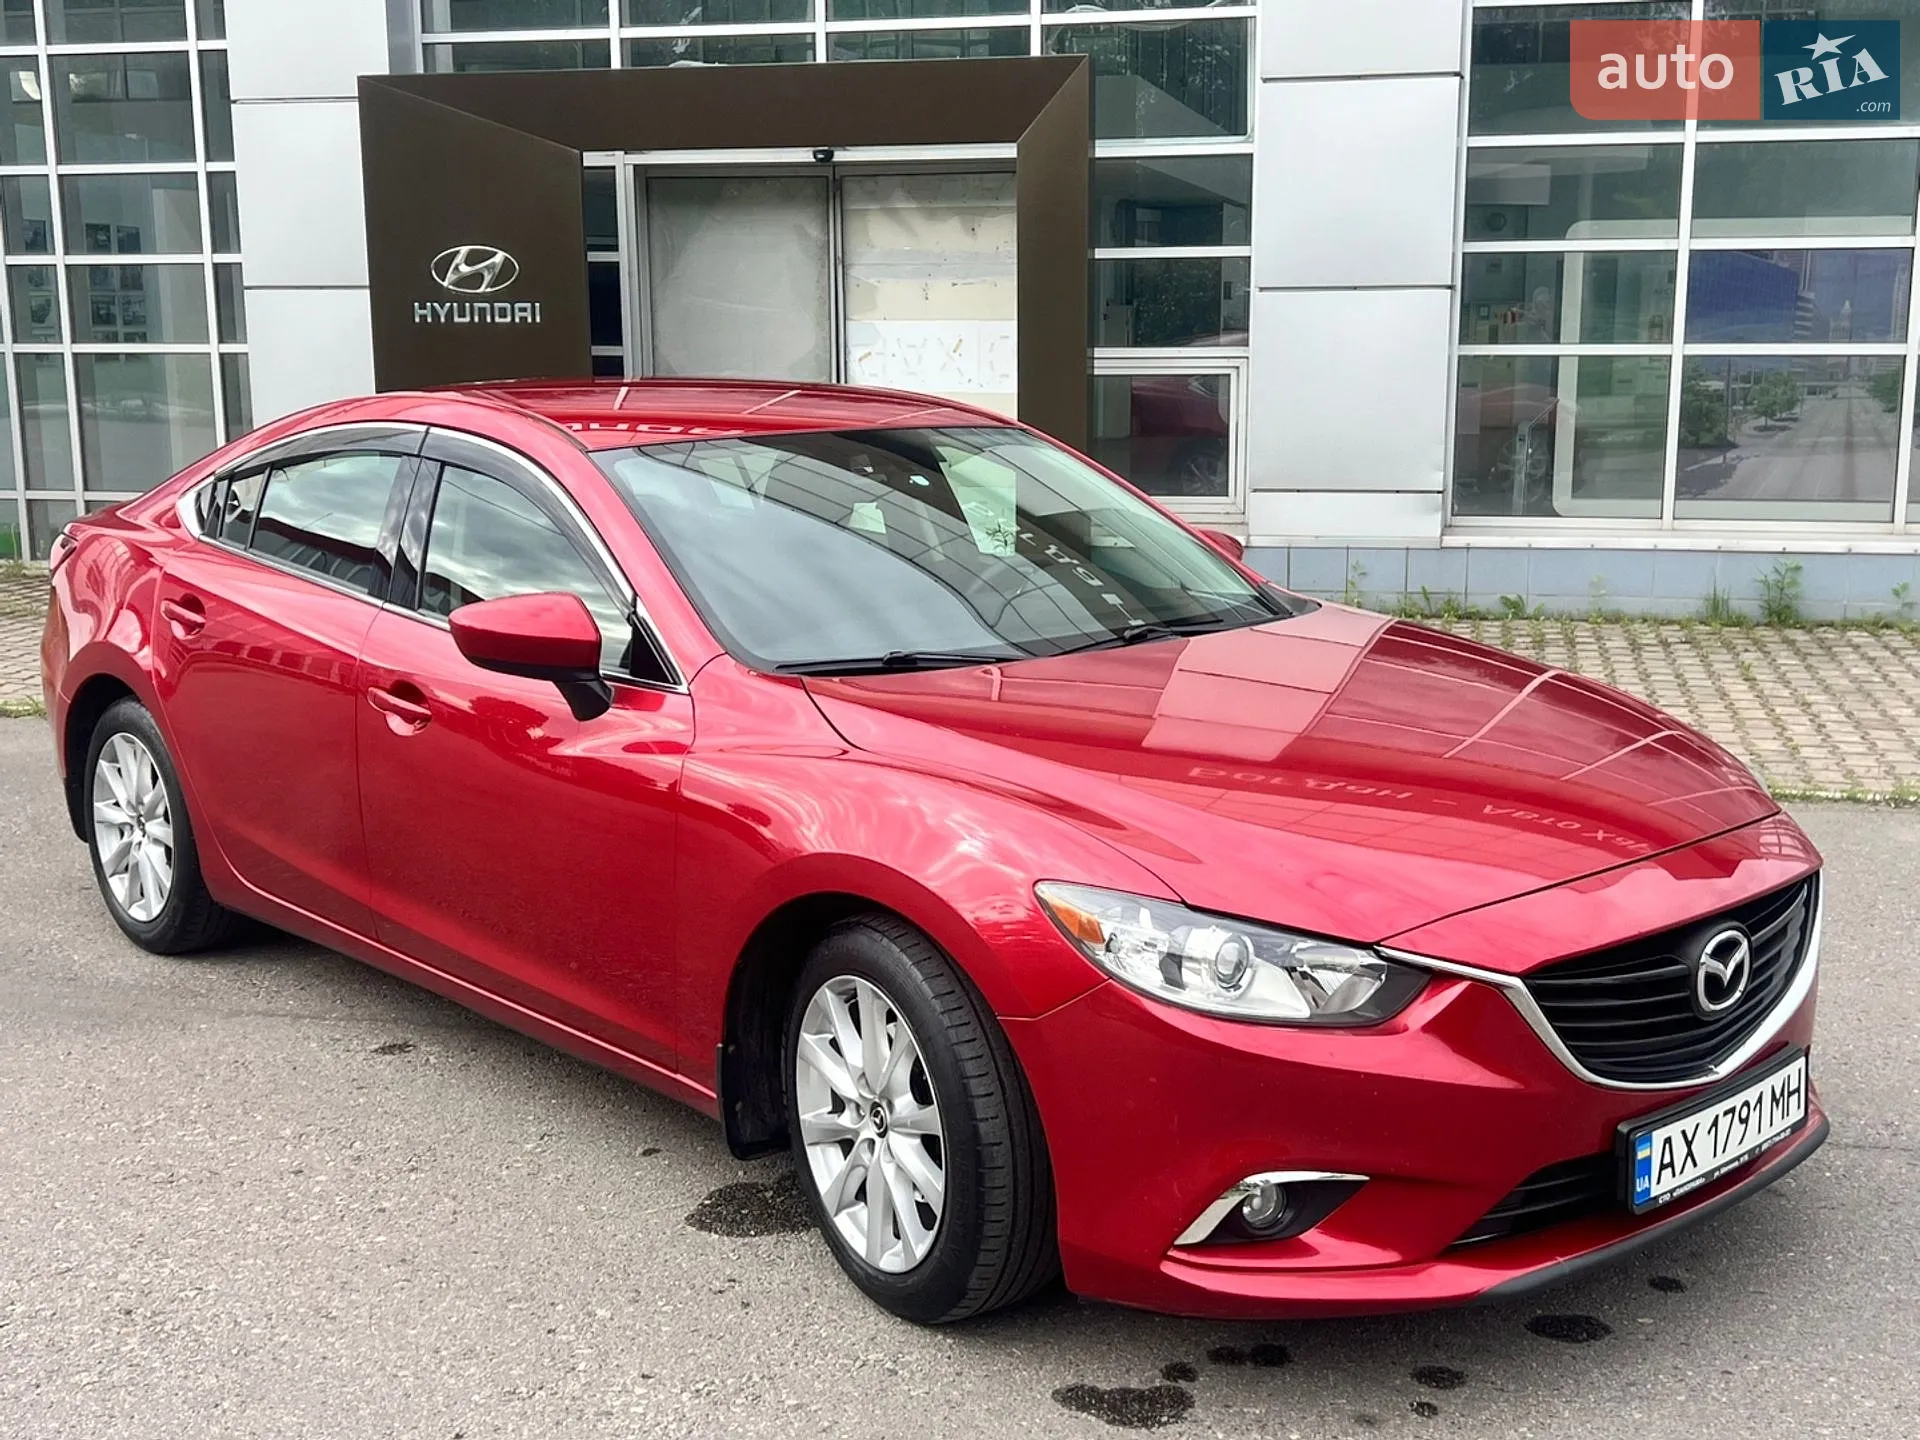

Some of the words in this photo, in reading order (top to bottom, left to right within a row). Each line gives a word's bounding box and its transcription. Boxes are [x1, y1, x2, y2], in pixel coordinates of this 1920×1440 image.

[413, 302, 541, 324] HYUNDAI
[1656, 1122, 1700, 1186] AX
[1707, 1090, 1764, 1159] 1791
[1770, 1067, 1802, 1128] MH
[1636, 1176, 1650, 1193] UA
